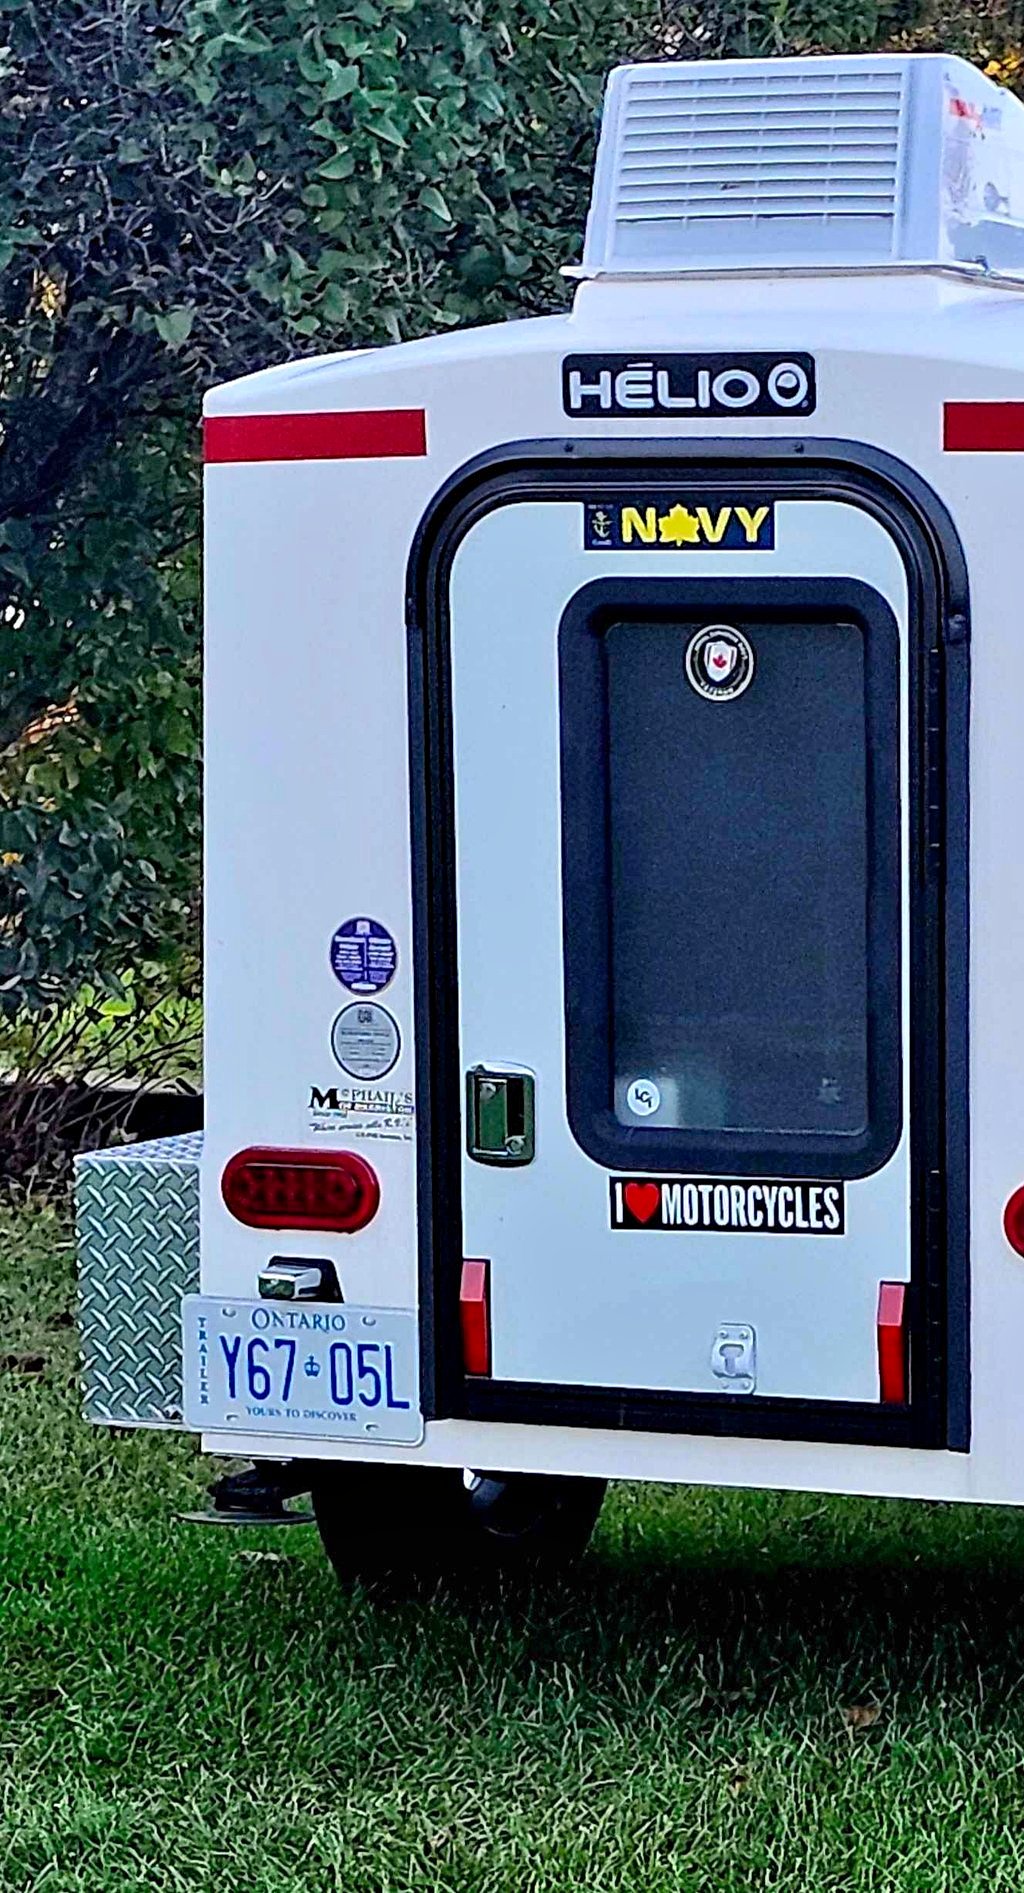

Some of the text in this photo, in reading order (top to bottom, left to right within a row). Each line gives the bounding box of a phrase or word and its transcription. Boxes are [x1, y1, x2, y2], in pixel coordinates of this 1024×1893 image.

[615, 1182, 841, 1229] I MOTORCYCLES
[197, 1317, 209, 1404] TRAILER
[219, 1335, 410, 1409] Y67 05L
[246, 1406, 357, 1421] YOURS TO DISCOVER
